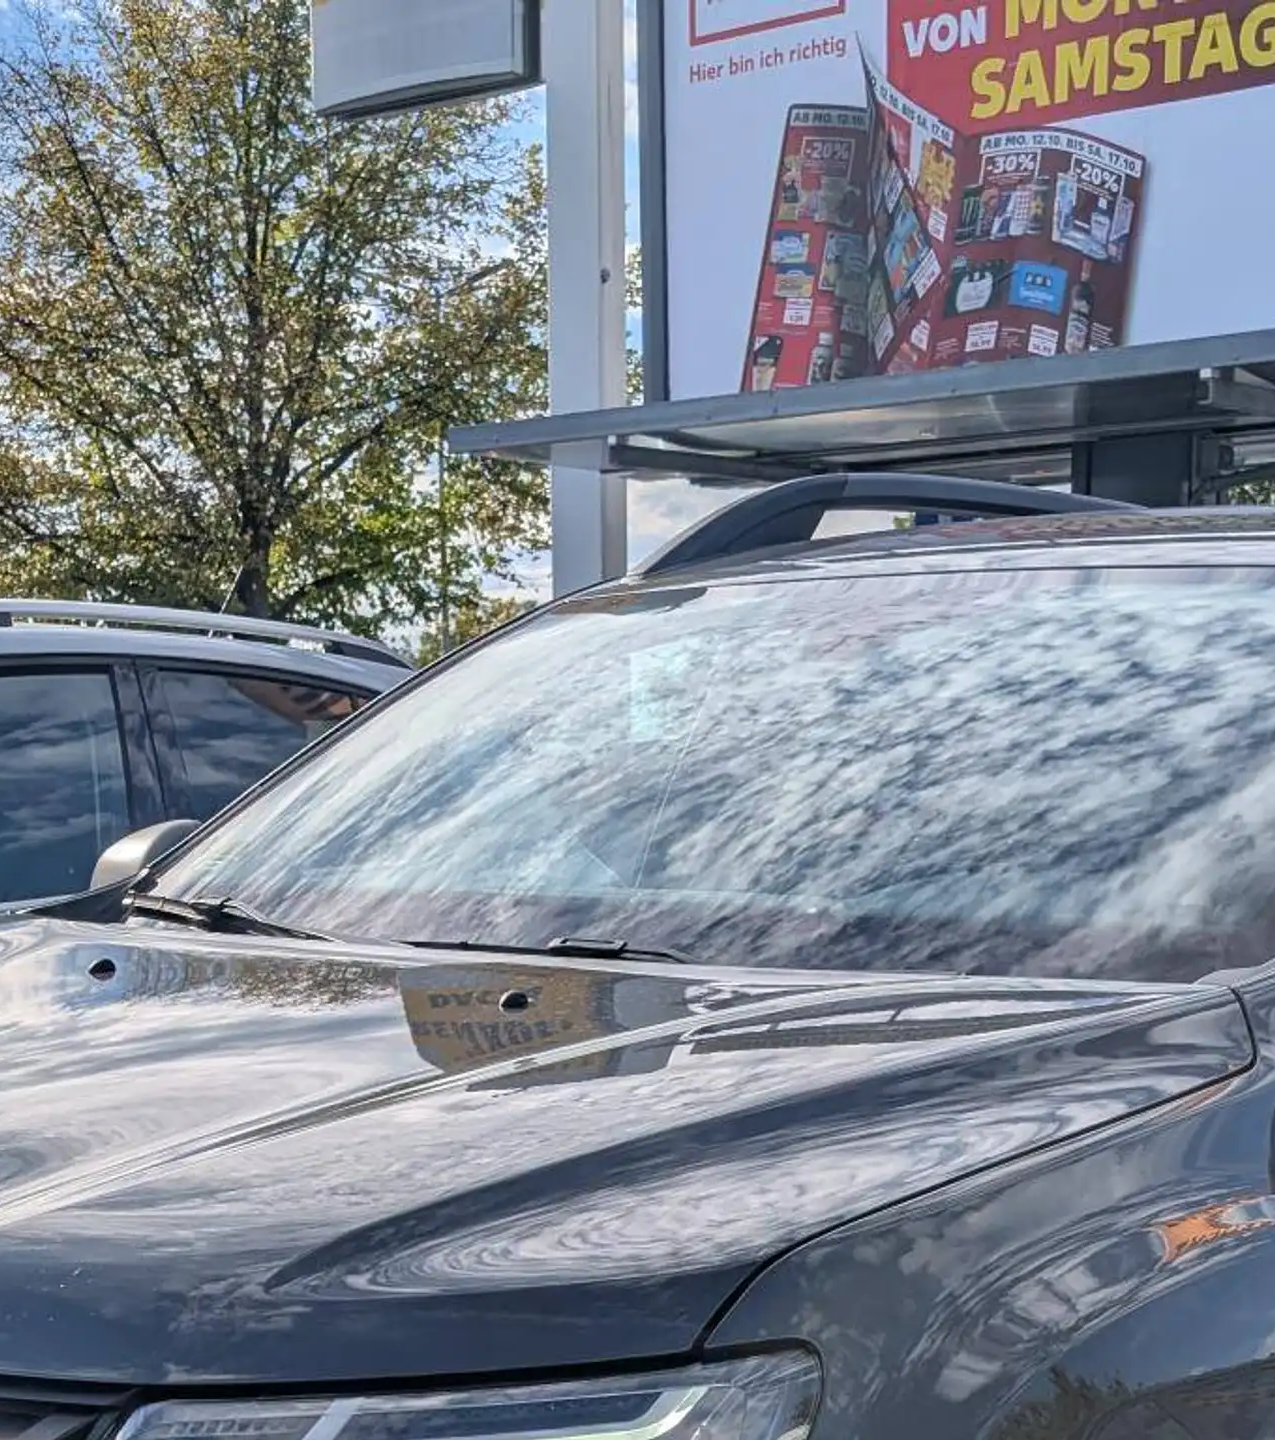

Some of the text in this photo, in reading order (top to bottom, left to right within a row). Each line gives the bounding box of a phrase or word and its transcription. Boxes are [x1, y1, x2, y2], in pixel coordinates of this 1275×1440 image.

[901, 6, 987, 58] VON
[689, 36, 847, 83] Hier bin ich richtig
[984, 136, 1002, 149] AB
[1066, 138, 1085, 152] BIS
[986, 153, 1035, 174] -30%
[1075, 163, 1119, 193] -20%
